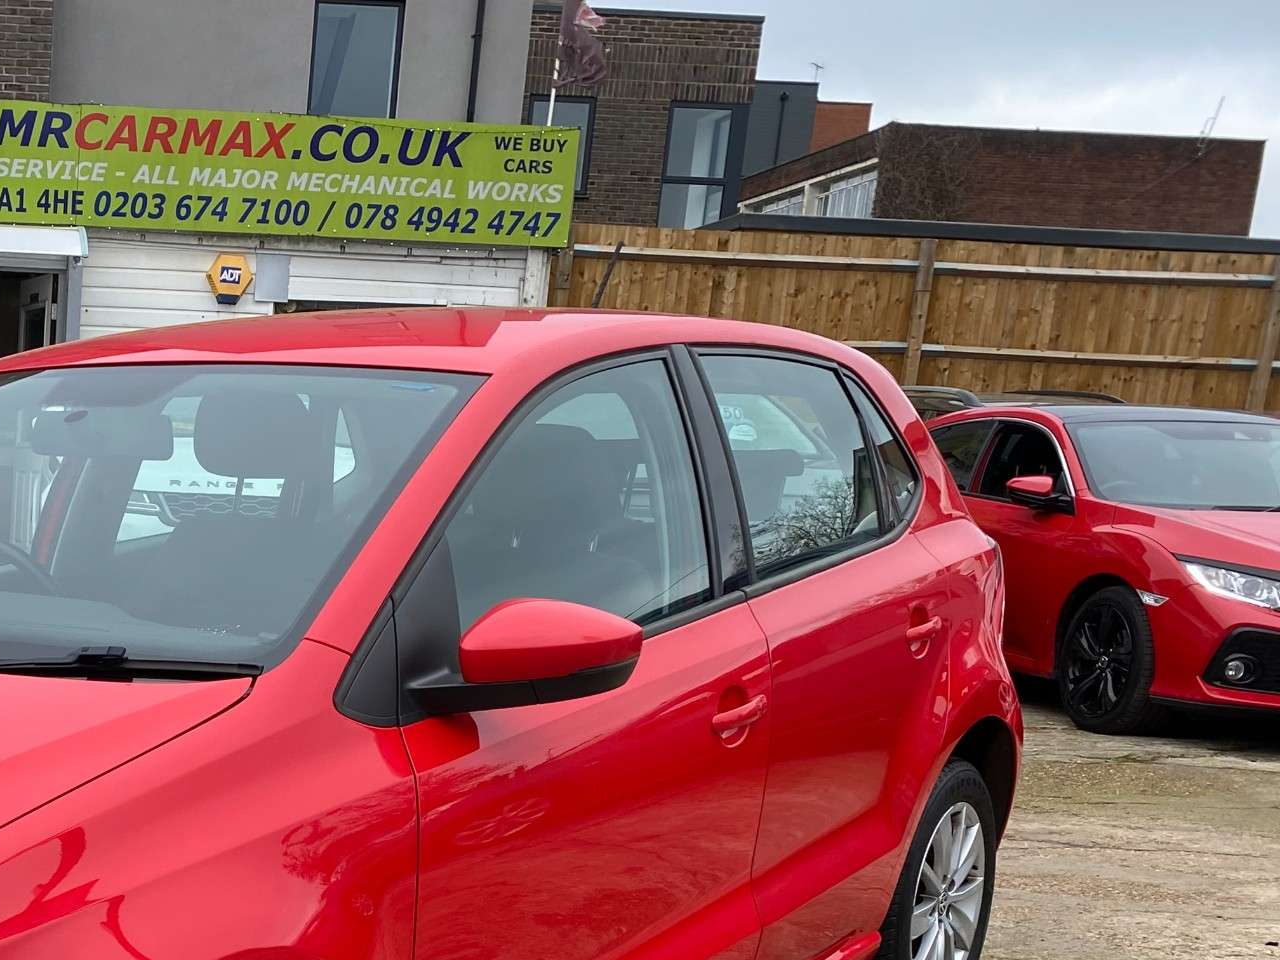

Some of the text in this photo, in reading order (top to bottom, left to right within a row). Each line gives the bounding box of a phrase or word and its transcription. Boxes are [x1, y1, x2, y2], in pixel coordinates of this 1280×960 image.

[494, 136, 568, 153] WE BUY
[503, 158, 553, 175] CARS
[132, 164, 179, 186] ALL
[188, 167, 277, 190] MAJOR
[286, 172, 456, 199] MECHANICAL
[468, 180, 564, 204] WORKS
[36, 188, 84, 216] 4HE
[94, 191, 166, 219] 0203
[175, 194, 228, 222] 674
[238, 197, 310, 226] 7100
[344, 202, 399, 231] 078
[407, 206, 479, 235] 4942
[487, 210, 561, 238] 4747
[220, 269, 242, 282] ADT
